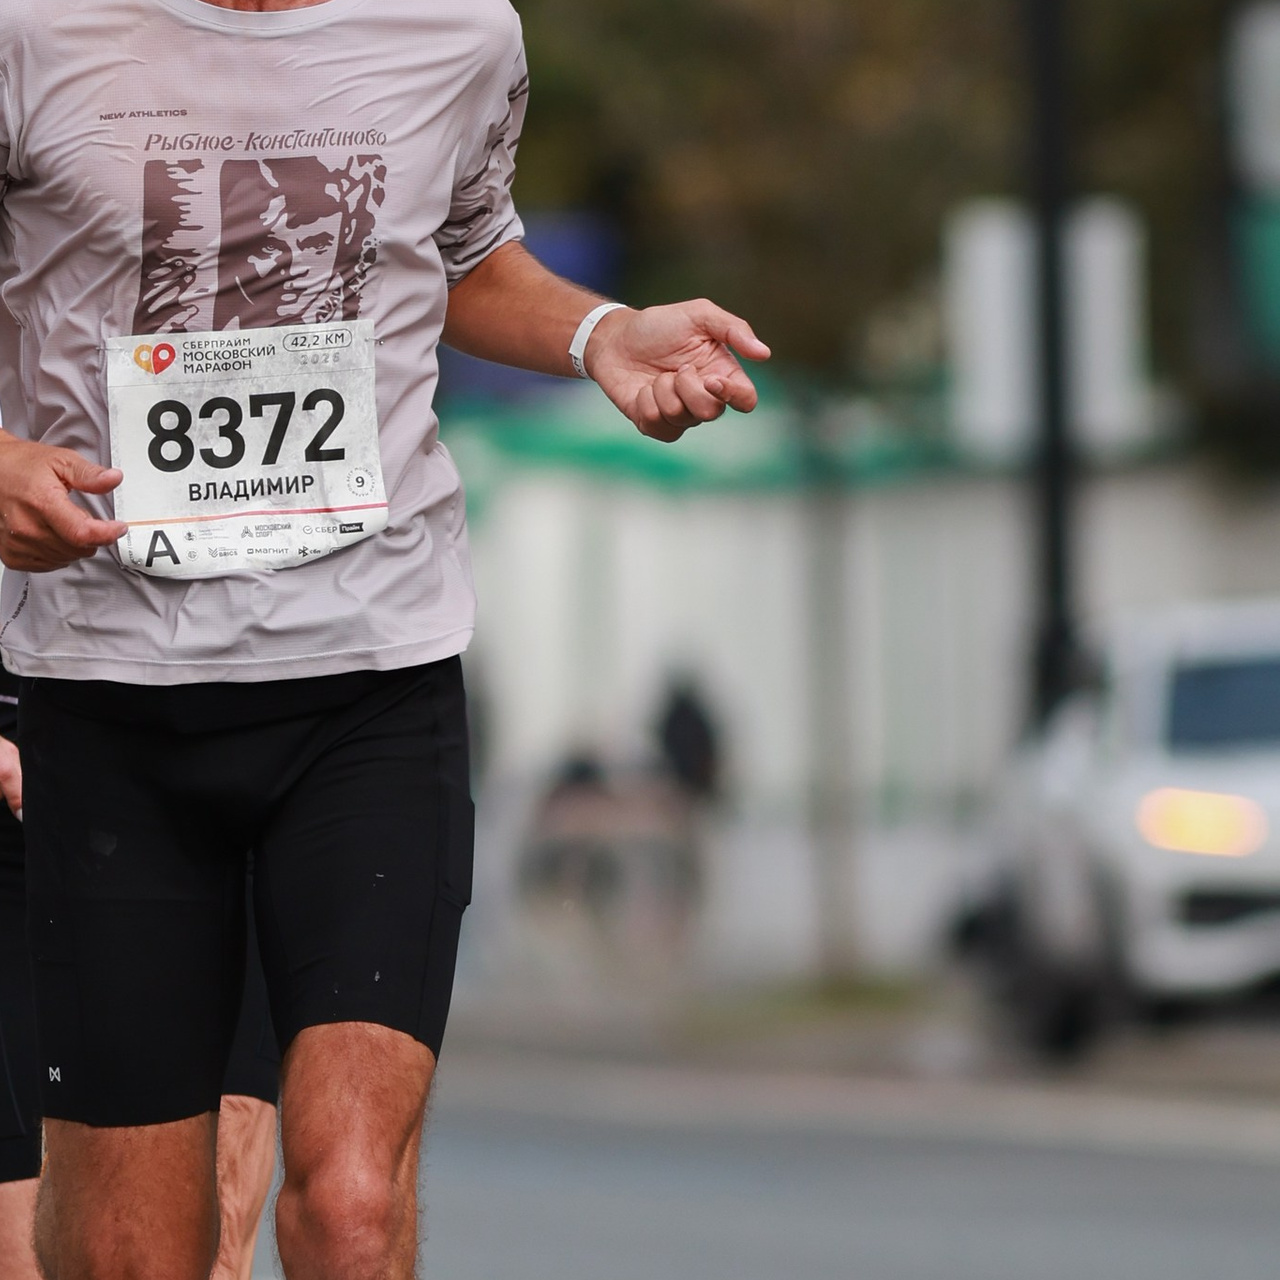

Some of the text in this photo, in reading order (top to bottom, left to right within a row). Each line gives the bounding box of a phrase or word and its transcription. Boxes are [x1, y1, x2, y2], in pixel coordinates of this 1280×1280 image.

[99, 109, 188, 121] NEW ATHLETICS
[182, 337, 251, 350] СБЕРПРАЙМ
[291, 334, 320, 348] 42,2
[183, 344, 276, 362] МОСКОВСКИЙ
[183, 360, 252, 374] МАРАФОН
[146, 387, 346, 473] 8372
[188, 474, 315, 502] ВЛАДИМИР
[355, 475, 365, 488] 9
[315, 526, 338, 534] СБЕР
